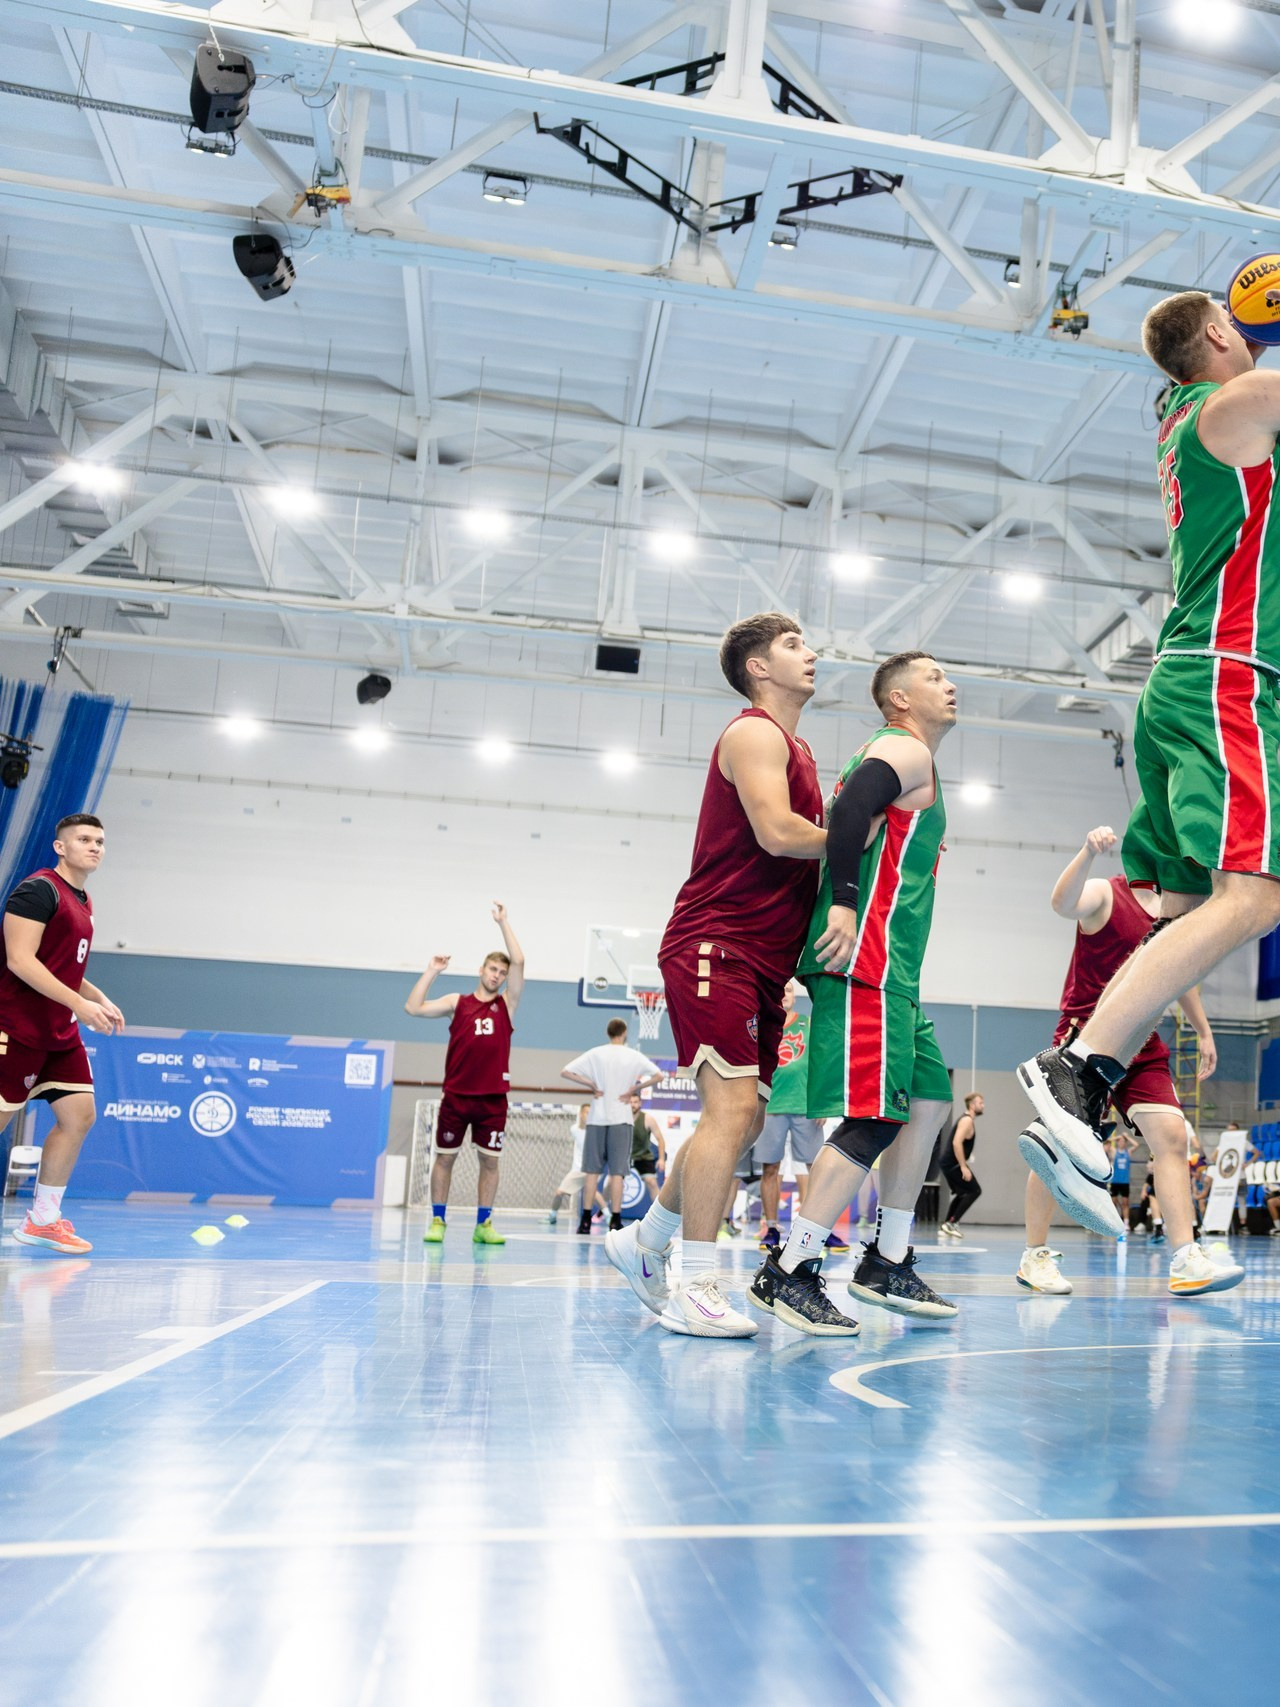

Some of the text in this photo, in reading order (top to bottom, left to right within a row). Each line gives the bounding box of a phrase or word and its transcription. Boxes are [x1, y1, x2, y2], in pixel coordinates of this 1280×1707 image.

[76, 938, 89, 964] 8
[474, 1017, 494, 1036] 13
[156, 1054, 184, 1066] ВСК
[103, 1102, 182, 1119] ДИНАМО
